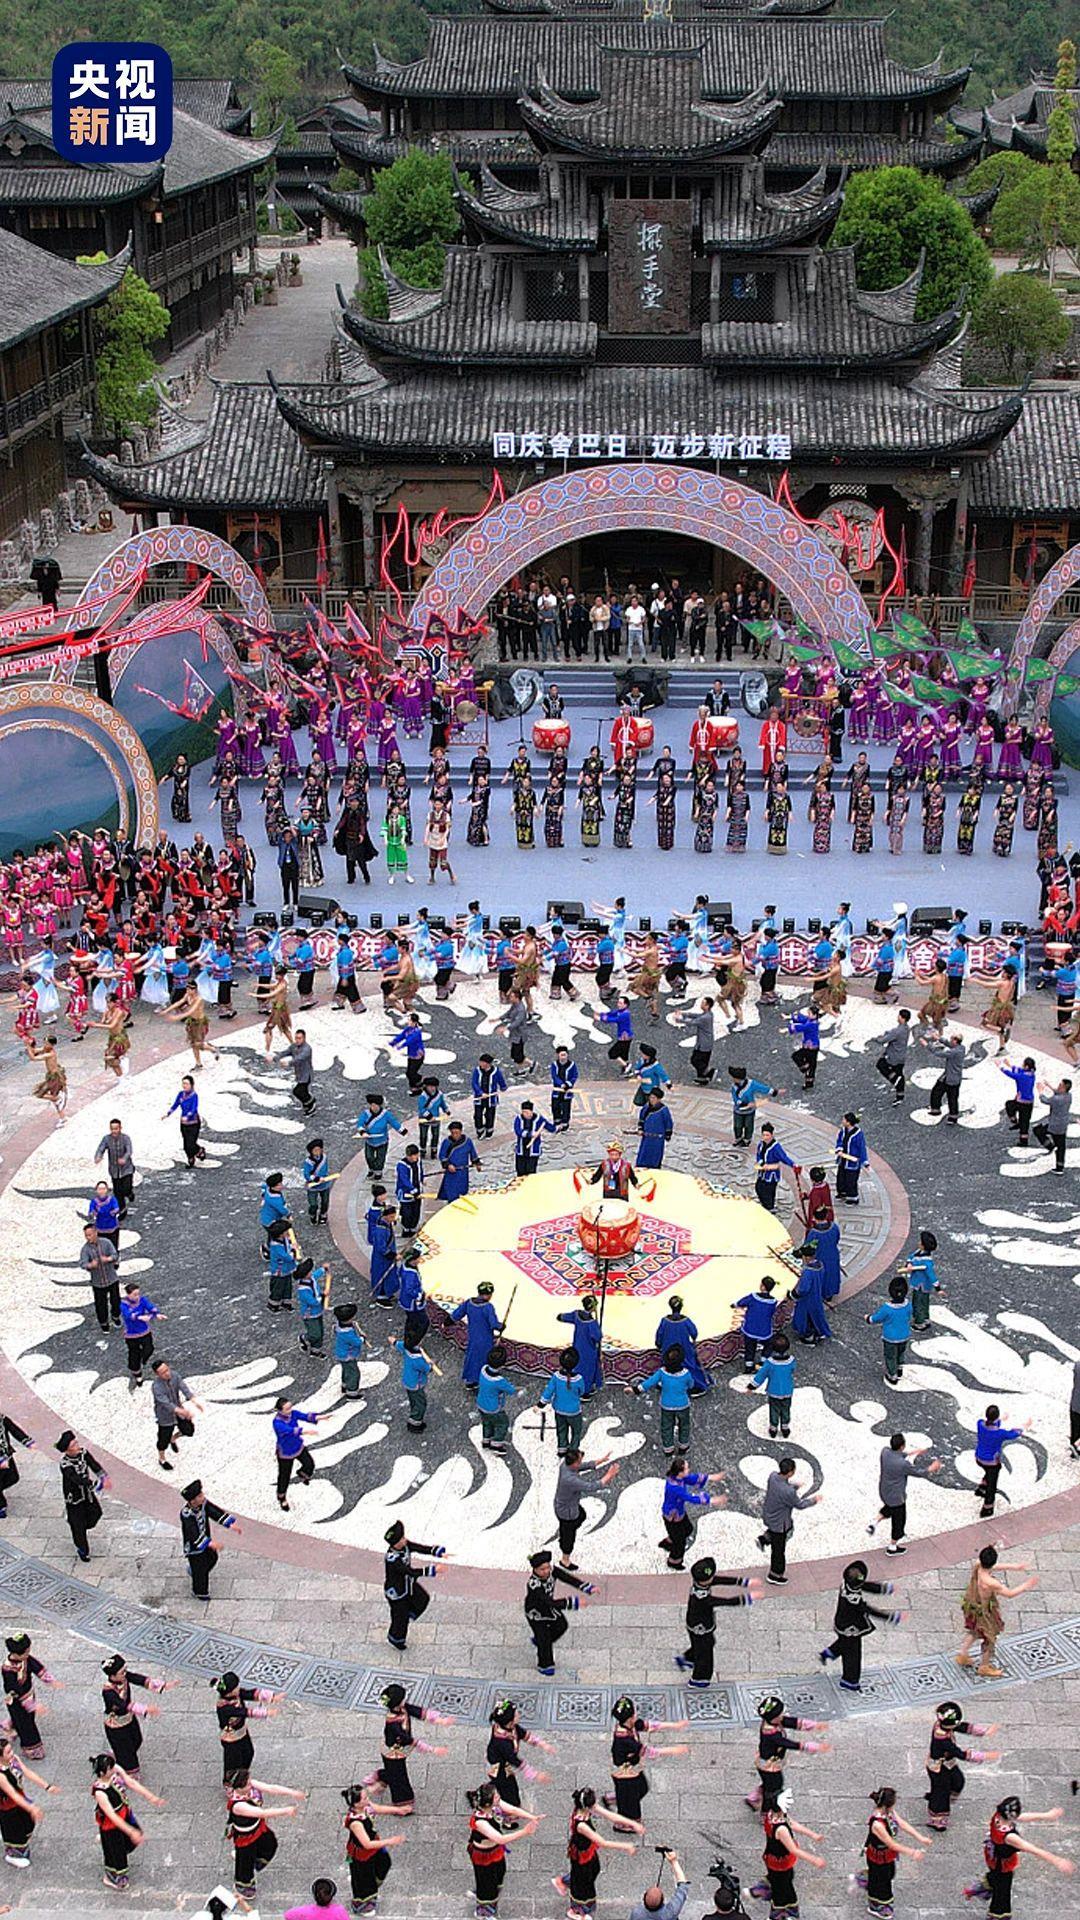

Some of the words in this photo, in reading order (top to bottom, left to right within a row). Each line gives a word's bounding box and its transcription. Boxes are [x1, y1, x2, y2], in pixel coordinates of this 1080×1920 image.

[493, 431, 627, 459] 同庆舍巴日
[651, 433, 792, 461] 迈步新征程
